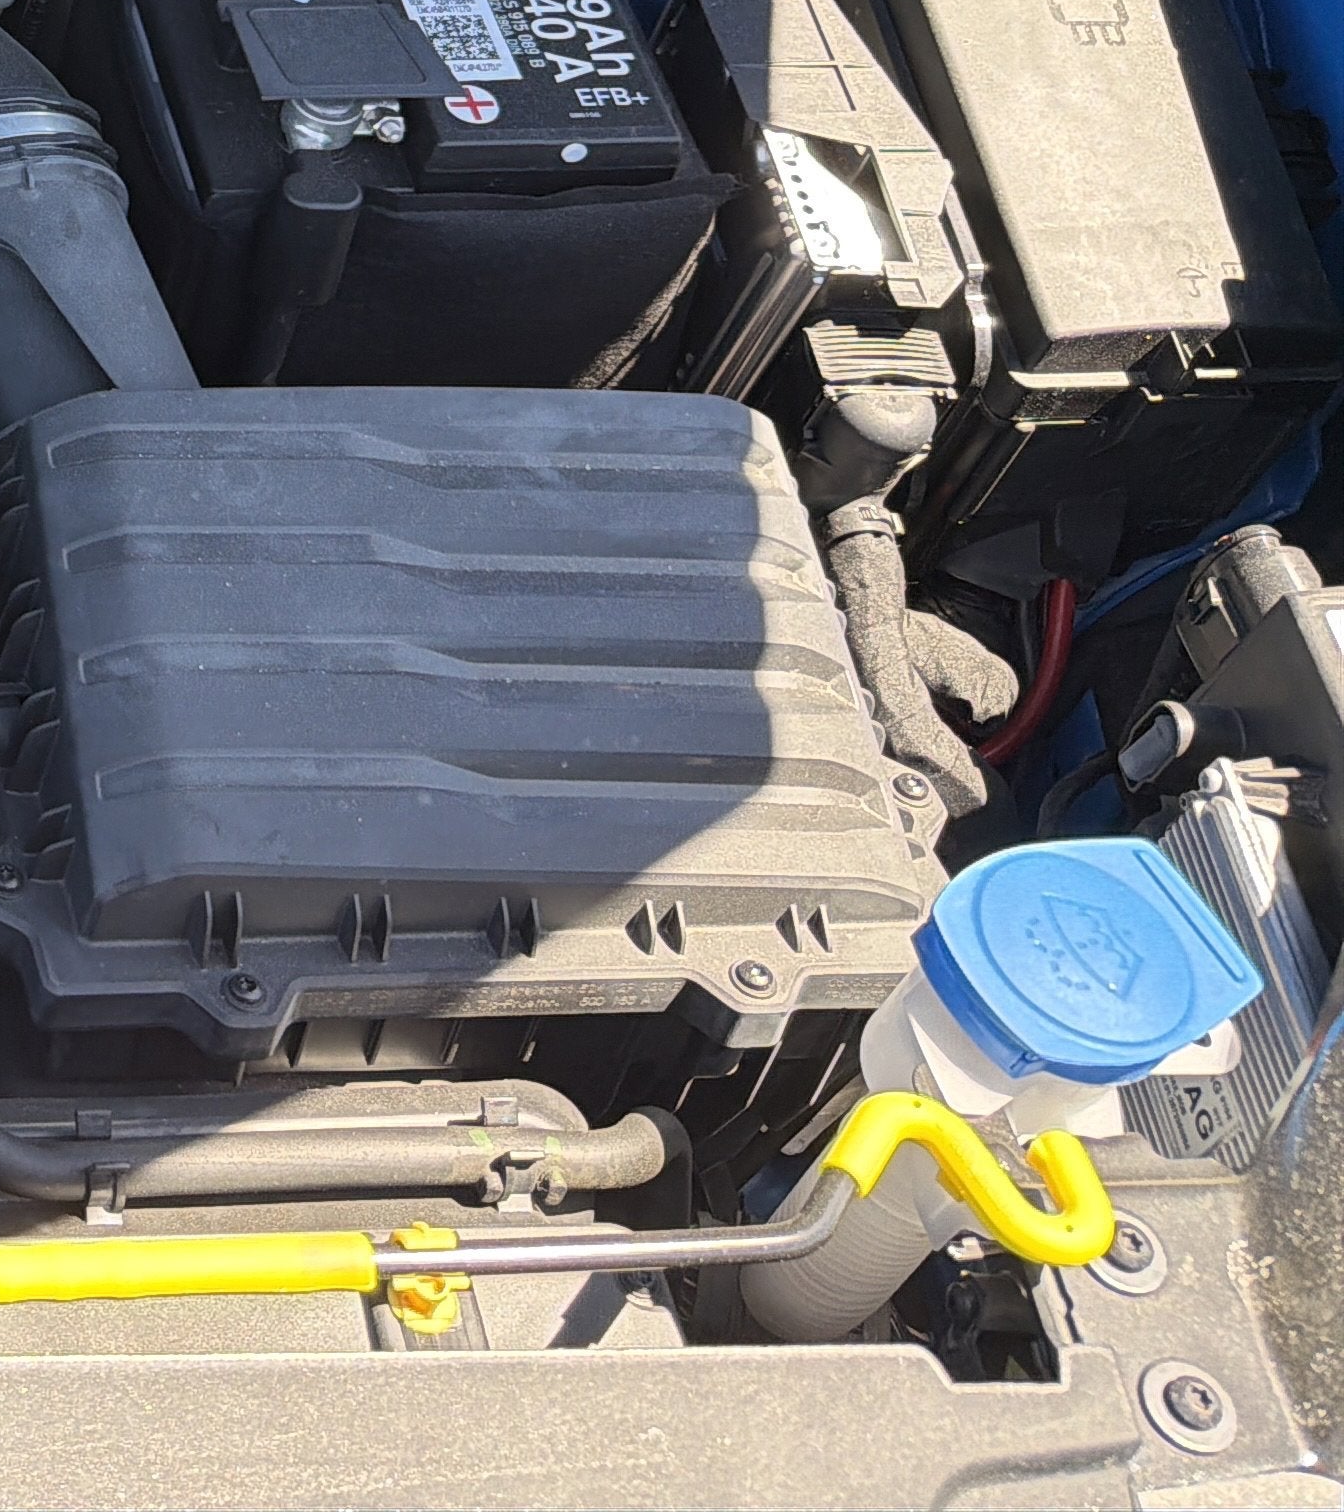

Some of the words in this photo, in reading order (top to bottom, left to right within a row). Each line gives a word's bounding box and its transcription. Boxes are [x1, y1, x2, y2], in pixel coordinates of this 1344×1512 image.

[542, 51, 599, 83] A
[574, 87, 650, 108] EFB+
[1183, 1085, 1215, 1140] AG
